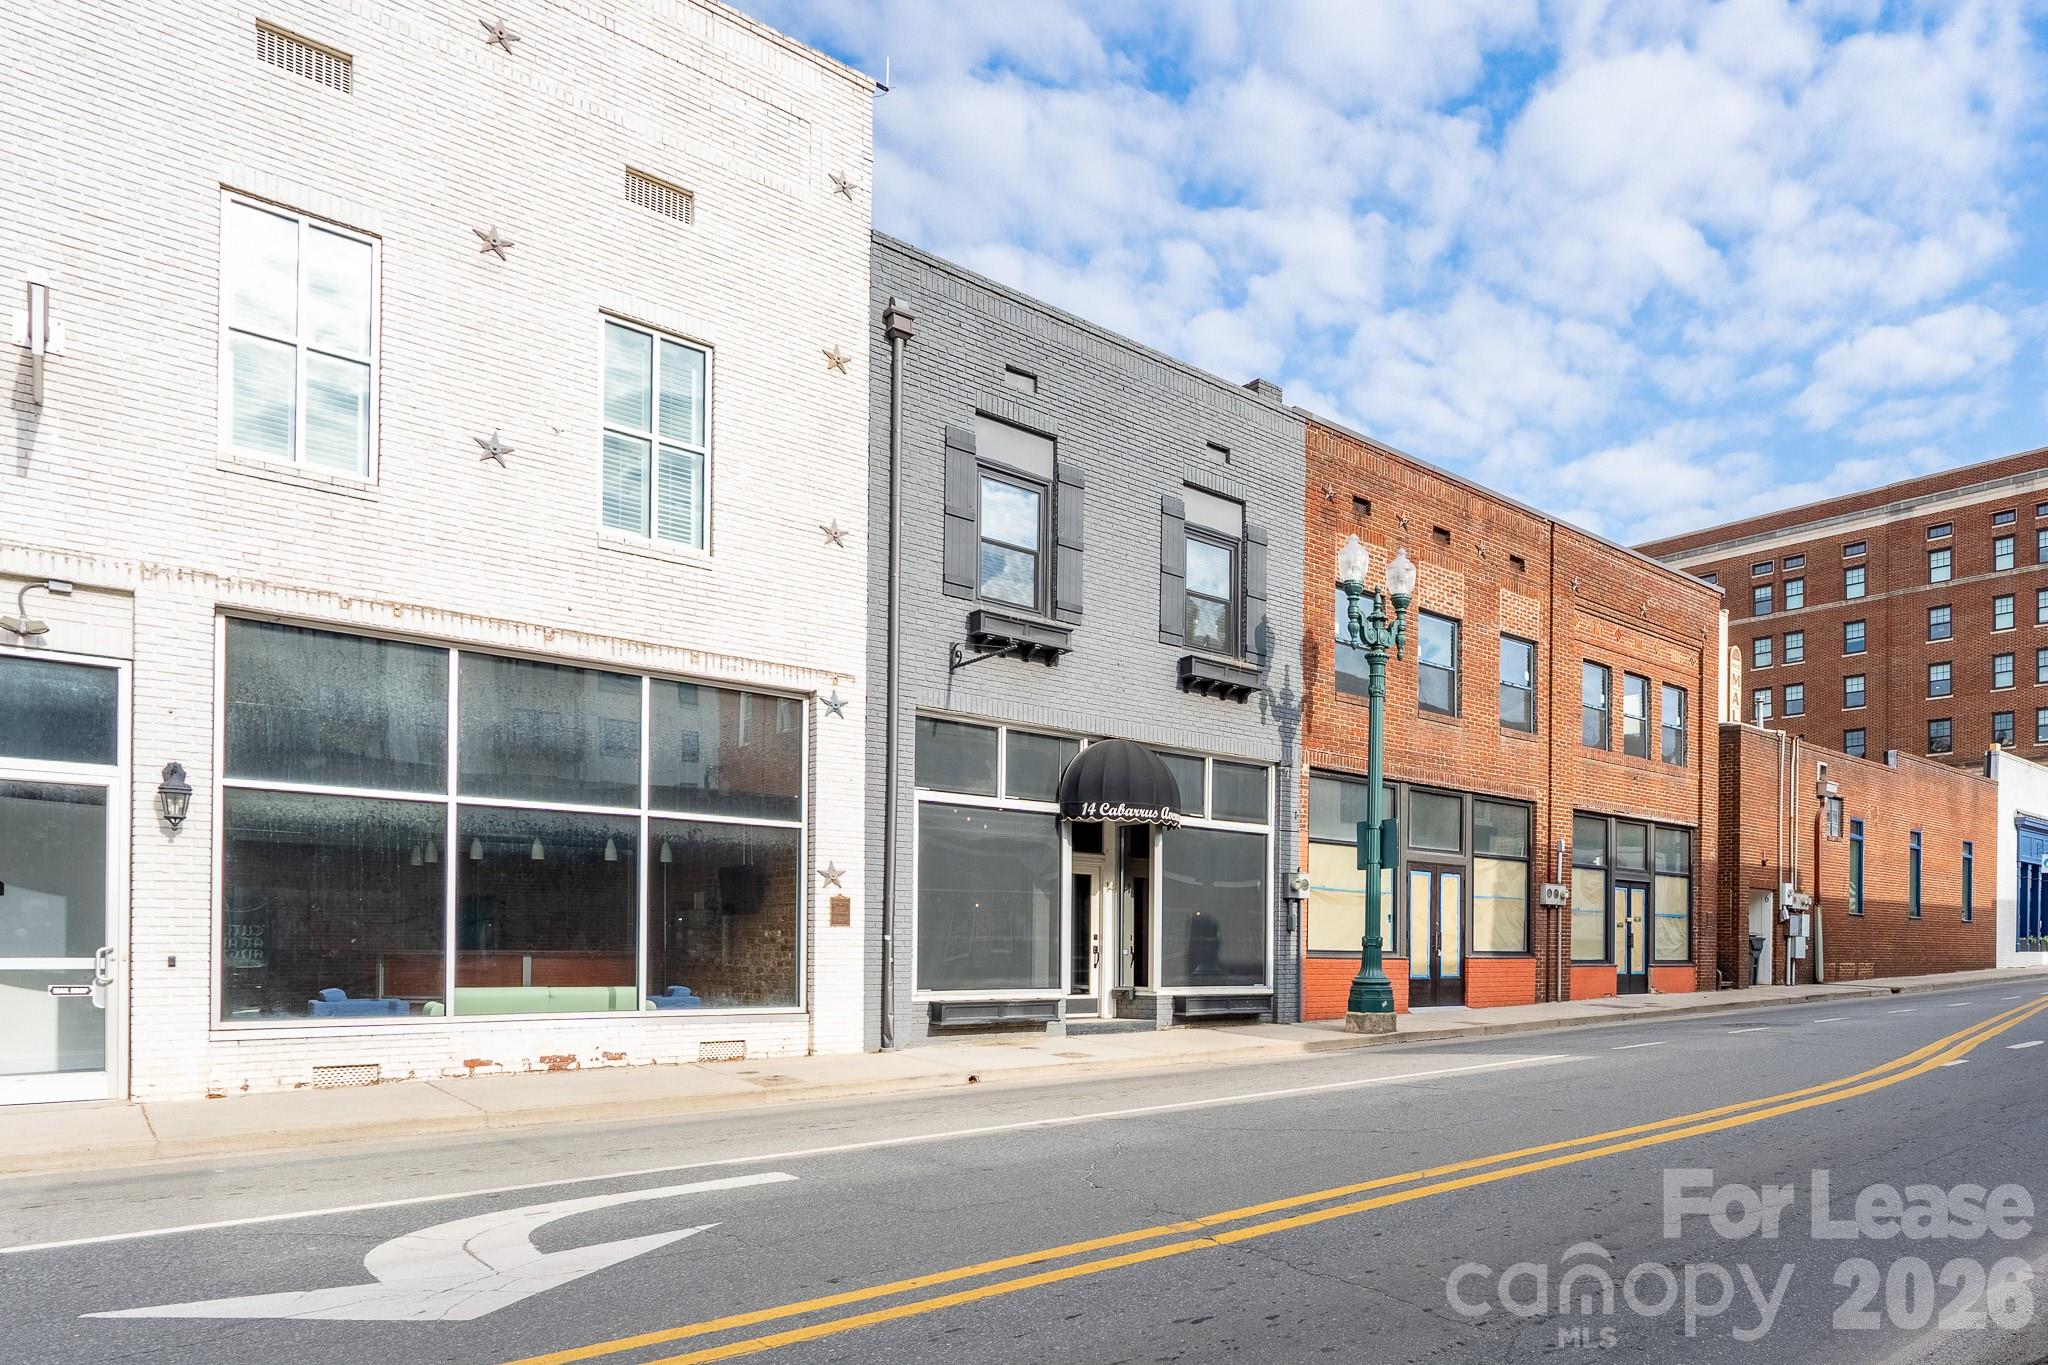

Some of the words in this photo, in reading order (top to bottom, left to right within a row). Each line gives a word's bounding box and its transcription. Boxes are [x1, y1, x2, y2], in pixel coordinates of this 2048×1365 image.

[1082, 802, 1097, 816] 14
[1100, 802, 1159, 819] Cabarrus
[1161, 806, 1181, 821] Ave
[1764, 894, 1769, 903] 6
